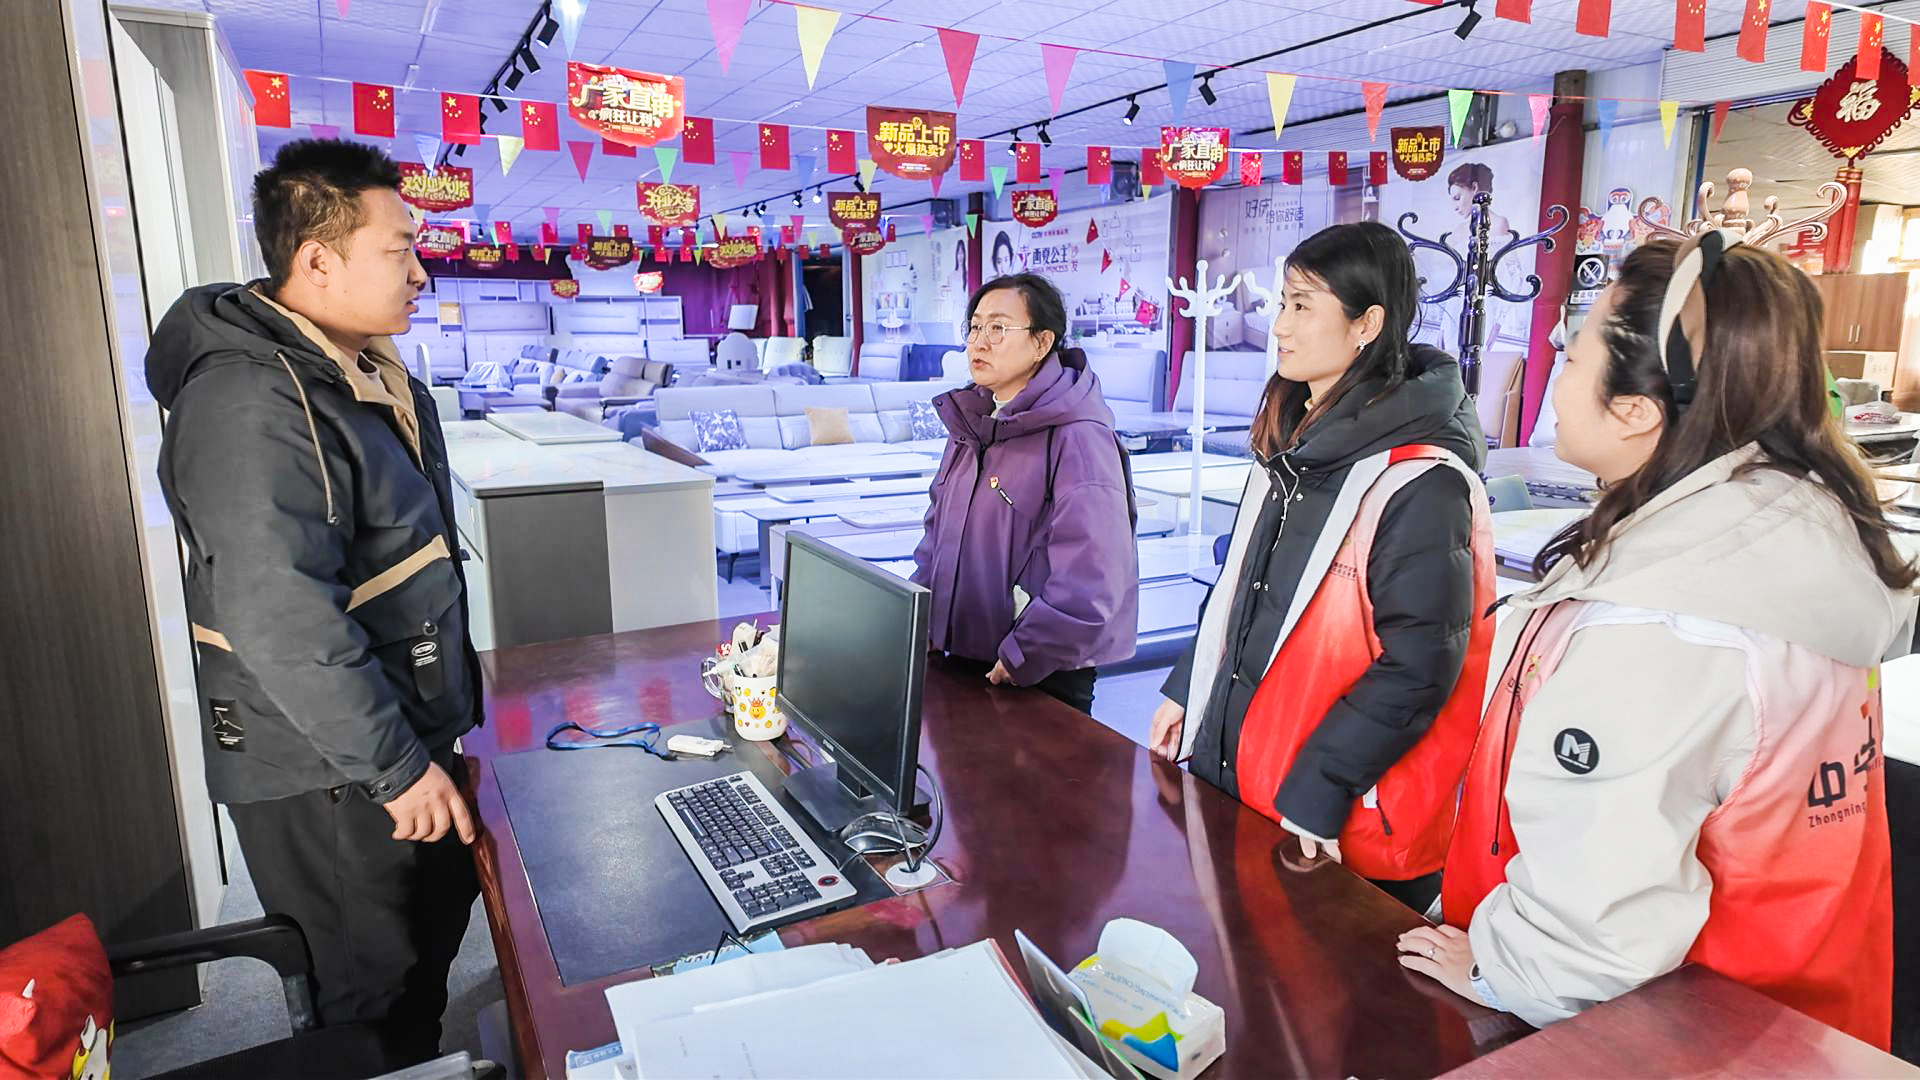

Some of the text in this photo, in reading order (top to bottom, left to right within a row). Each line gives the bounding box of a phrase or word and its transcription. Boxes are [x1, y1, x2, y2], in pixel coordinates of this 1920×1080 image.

[572, 82, 674, 118] 厂家直销
[1835, 79, 1881, 122] 福
[599, 107, 653, 127] 疯狂让利
[875, 121, 950, 145] 新品上市
[892, 142, 939, 157] 火爆热卖
[1163, 141, 1224, 162] 厂家直销
[1395, 136, 1440, 153] 新品上市
[832, 199, 878, 211] 新品上市
